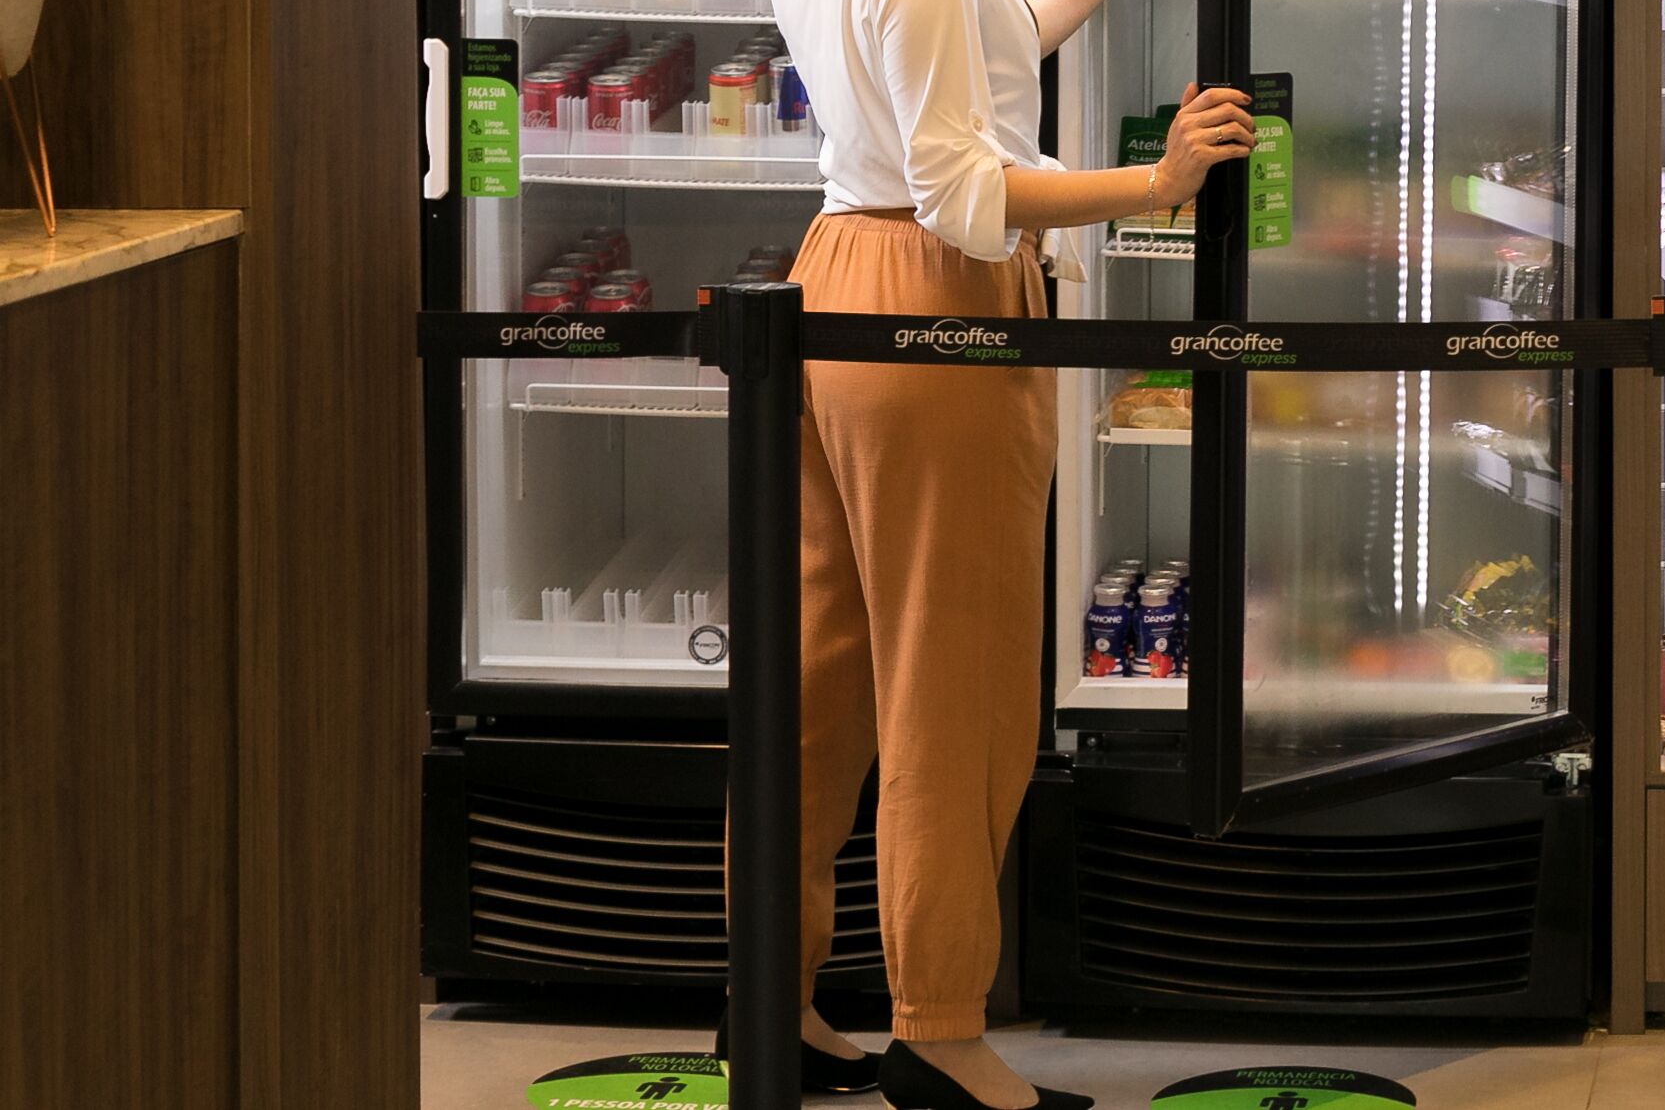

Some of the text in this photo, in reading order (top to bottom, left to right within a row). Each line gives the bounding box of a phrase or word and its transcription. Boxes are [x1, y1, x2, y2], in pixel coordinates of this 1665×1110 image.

[467, 87, 506, 99] FAÇA SUA
[467, 100, 497, 111] PARTE!
[500, 321, 606, 346] grancoffee
[895, 327, 1009, 351] grancoffee
[567, 341, 621, 356] express
[1170, 331, 1285, 355] grancoffee
[1446, 330, 1560, 354] grancoffee
[963, 345, 1022, 362] express
[1240, 350, 1298, 365] express
[1517, 347, 1575, 364] express
[640, 1063, 723, 1074] NO LOCAL
[1235, 1070, 1357, 1083] PERMANÊNCIA
[1253, 1077, 1333, 1088] NO LOCAL
[548, 1097, 702, 1110] 1 PESSOA POR
